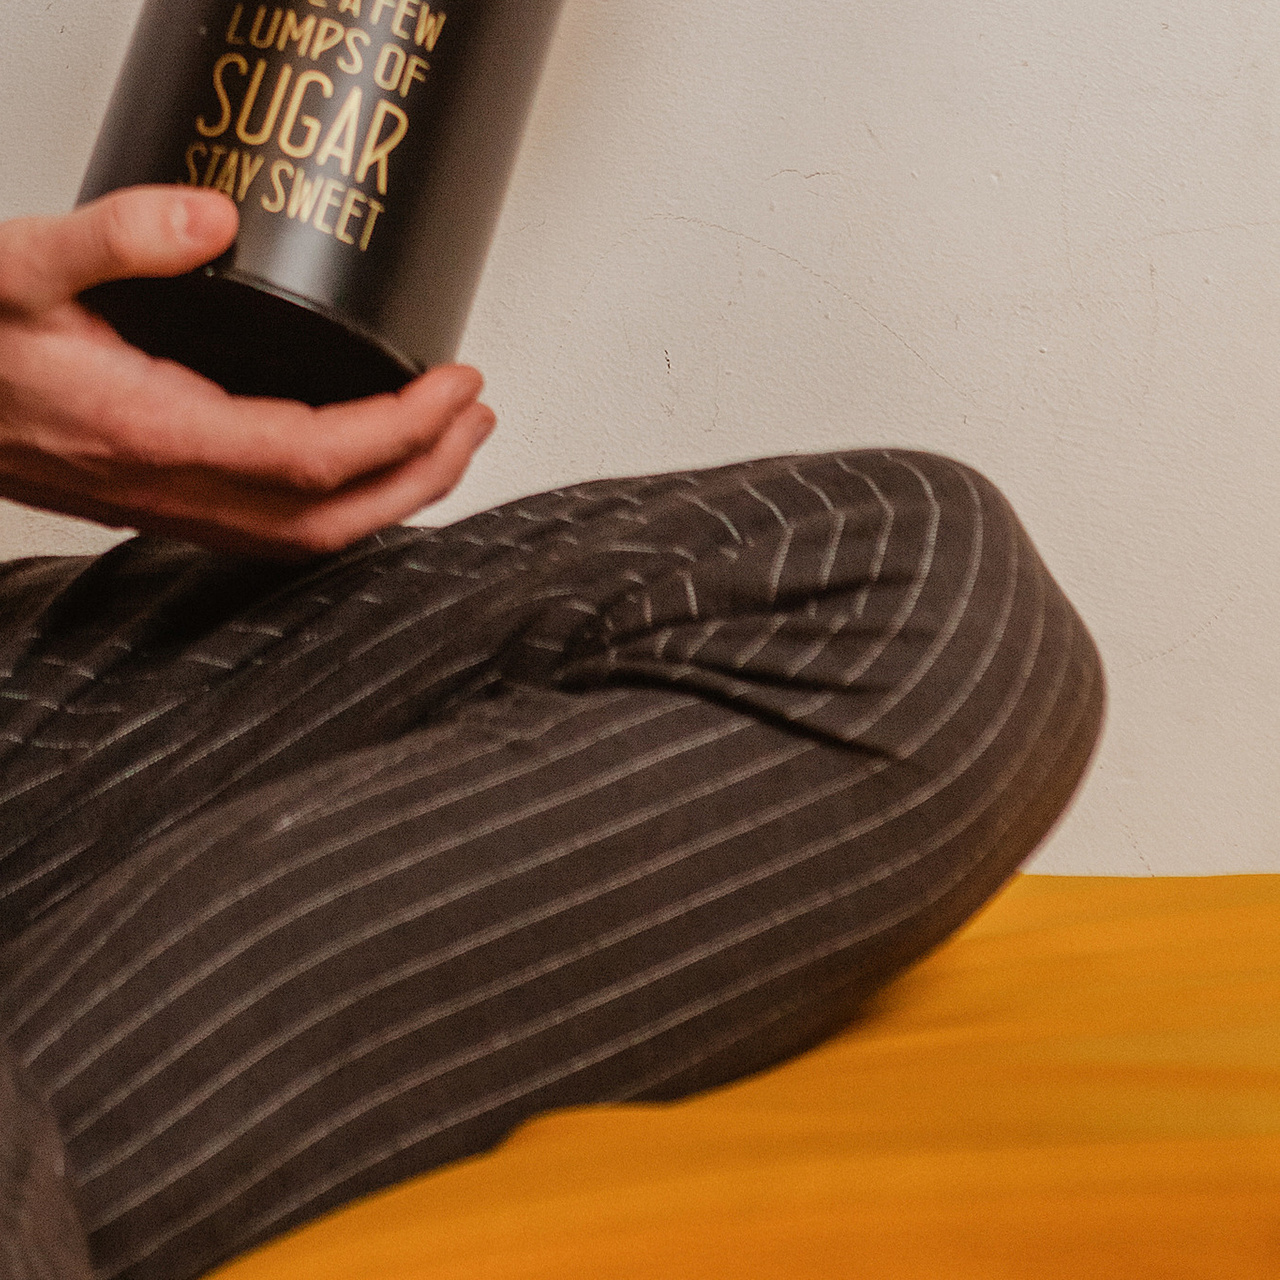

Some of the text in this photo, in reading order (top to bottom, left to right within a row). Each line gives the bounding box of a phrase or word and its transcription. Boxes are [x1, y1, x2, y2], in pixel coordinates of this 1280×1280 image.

[225, 3, 431, 98] LUMPS OF
[196, 52, 409, 196] SUGAR
[260, 159, 385, 251] SWEET
